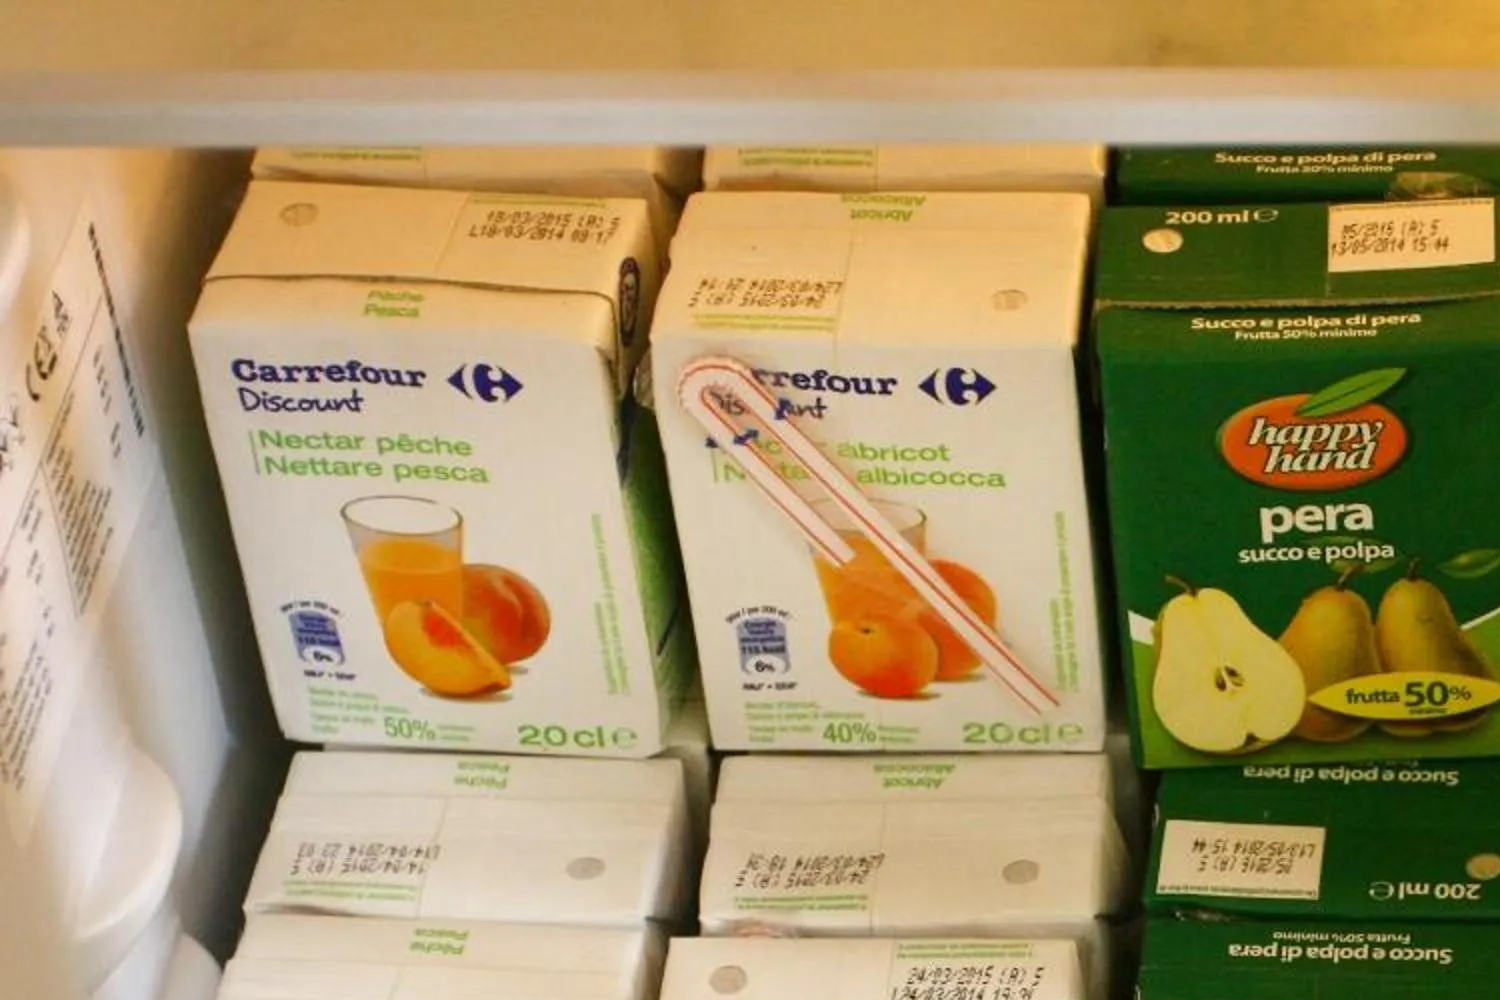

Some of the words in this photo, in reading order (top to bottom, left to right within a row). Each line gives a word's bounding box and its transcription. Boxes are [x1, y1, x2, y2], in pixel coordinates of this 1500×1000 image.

[1215, 152, 1278, 165] Succo
[1282, 154, 1294, 164] e
[1297, 152, 1360, 166] polpa
[1364, 151, 1384, 163] di
[1388, 151, 1437, 165] pera
[1165, 210, 1213, 226] 200
[1218, 209, 1249, 224] ml
[1191, 316, 1257, 330] Succo
[1260, 318, 1274, 329] e
[1277, 315, 1342, 331] polpa
[1346, 313, 1368, 327] di
[1371, 313, 1421, 329] pera
[1234, 329, 1280, 341] Frutta
[1319, 327, 1378, 340] minimo
[231, 358, 427, 387] Carrefour
[752, 368, 898, 396] rrefour
[237, 387, 364, 413] Discount
[258, 429, 365, 450] Nectar
[376, 433, 473, 457] pêche
[1247, 417, 1383, 451] happy
[837, 443, 950, 462] abricot
[1263, 441, 1377, 475] hand
[263, 455, 383, 477] Nettare
[393, 461, 489, 484] pesca
[857, 467, 1007, 488] albicocca
[1260, 503, 1374, 544] pera
[1238, 546, 1304, 564] succo
[1307, 547, 1321, 560] e
[1325, 542, 1395, 563] polpa
[1346, 688, 1399, 705] frutta
[1404, 681, 1473, 707] 50%
[384, 716, 436, 742] 50%
[823, 722, 876, 744] 40%
[1244, 766, 1290, 780] pera
[1294, 766, 1313, 782] di
[1318, 766, 1379, 784] polpa
[1382, 770, 1395, 782] e
[1398, 768, 1459, 785] Succo
[1399, 884, 1429, 900] ml
[1434, 883, 1481, 899] 200
[1274, 931, 1329, 942] minimo
[1367, 933, 1411, 943] Frutta
[1229, 942, 1277, 958] pera
[1282, 946, 1302, 963] di
[1308, 944, 1369, 963] polpa
[1373, 948, 1385, 959] e
[1389, 948, 1453, 965] Succo
